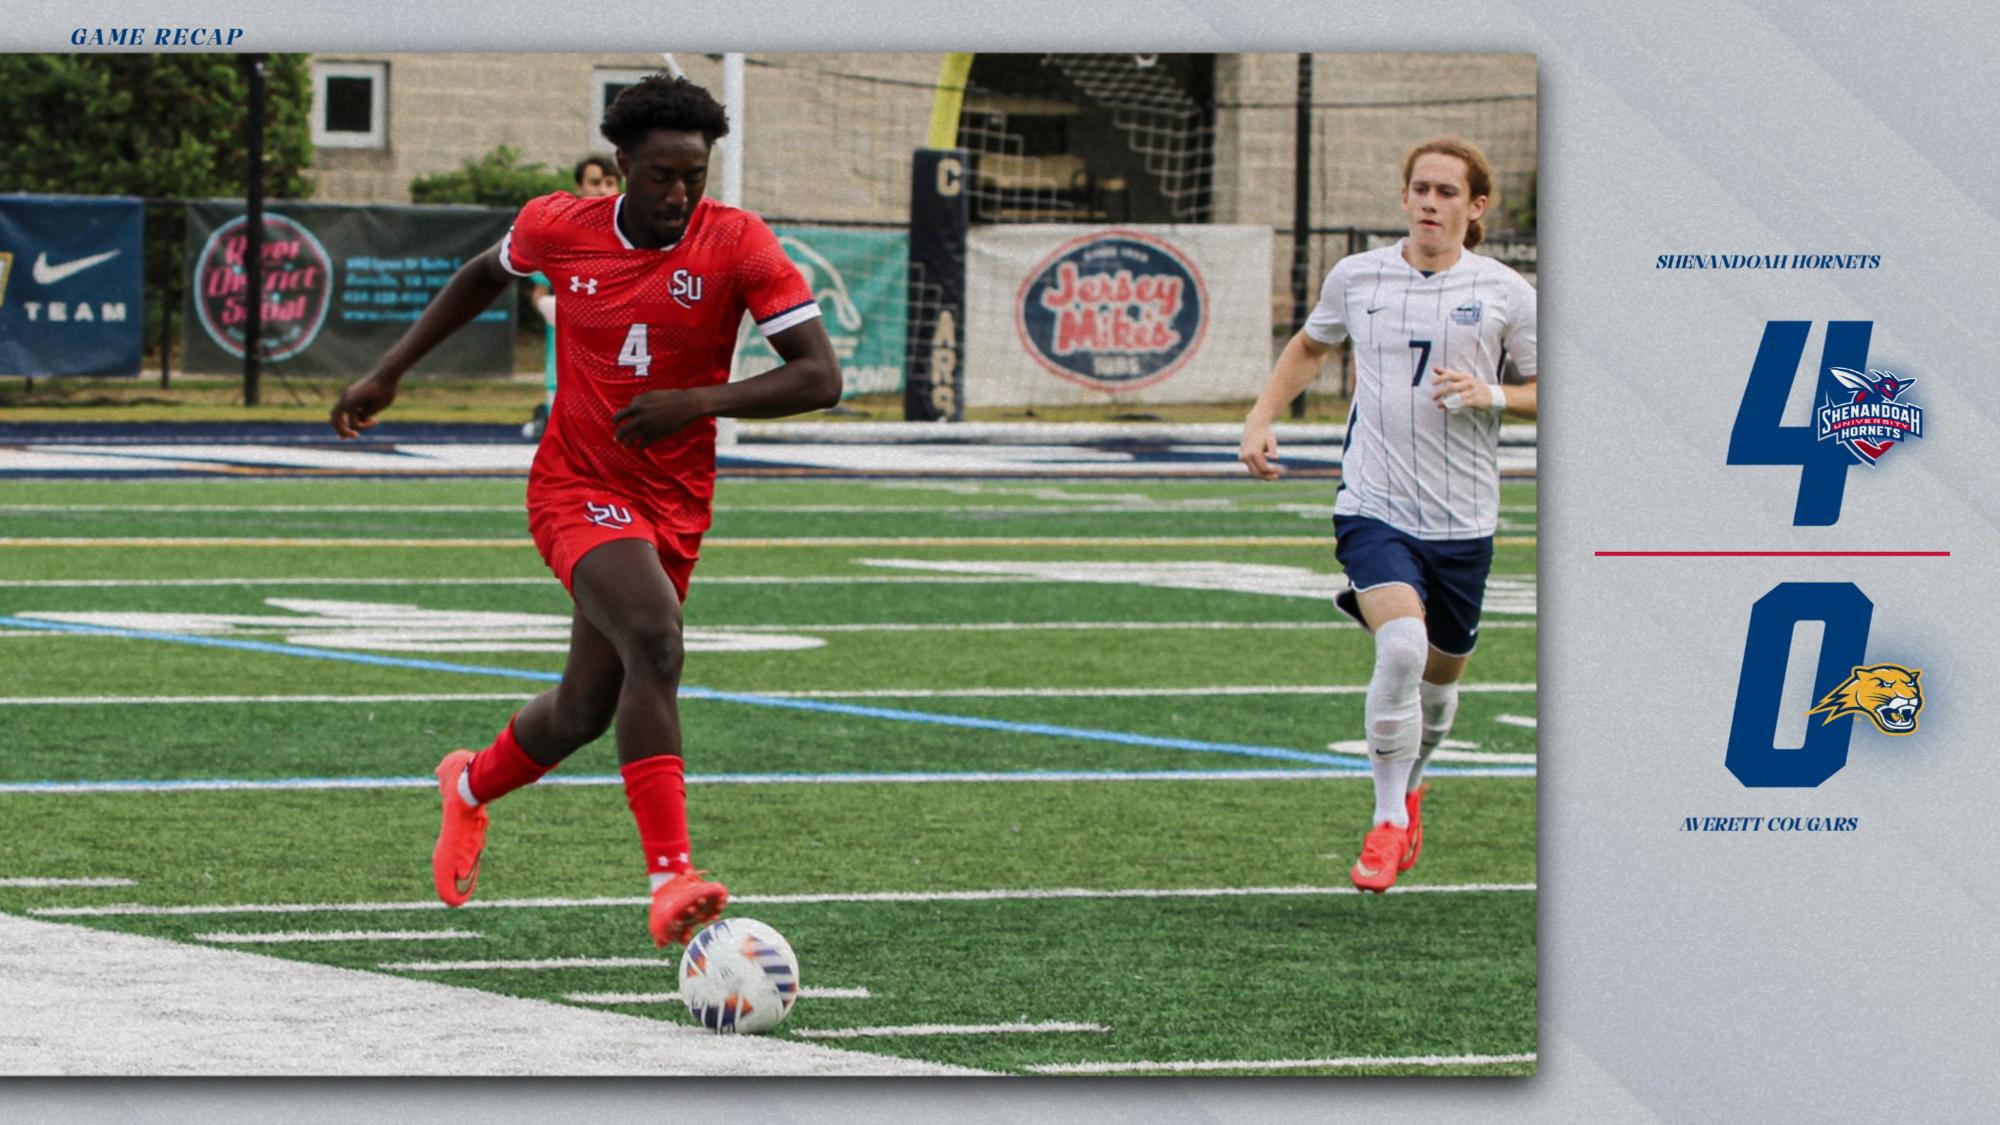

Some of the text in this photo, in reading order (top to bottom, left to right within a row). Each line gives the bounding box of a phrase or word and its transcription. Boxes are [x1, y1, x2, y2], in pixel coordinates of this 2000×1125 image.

[671, 269, 702, 301] SU
[1041, 262, 1184, 318] Jersey
[24, 301, 127, 322] TEAM
[1052, 307, 1182, 355] Mike's
[617, 322, 653, 377] 4
[1408, 340, 1432, 387] 7
[585, 500, 633, 524] SU
